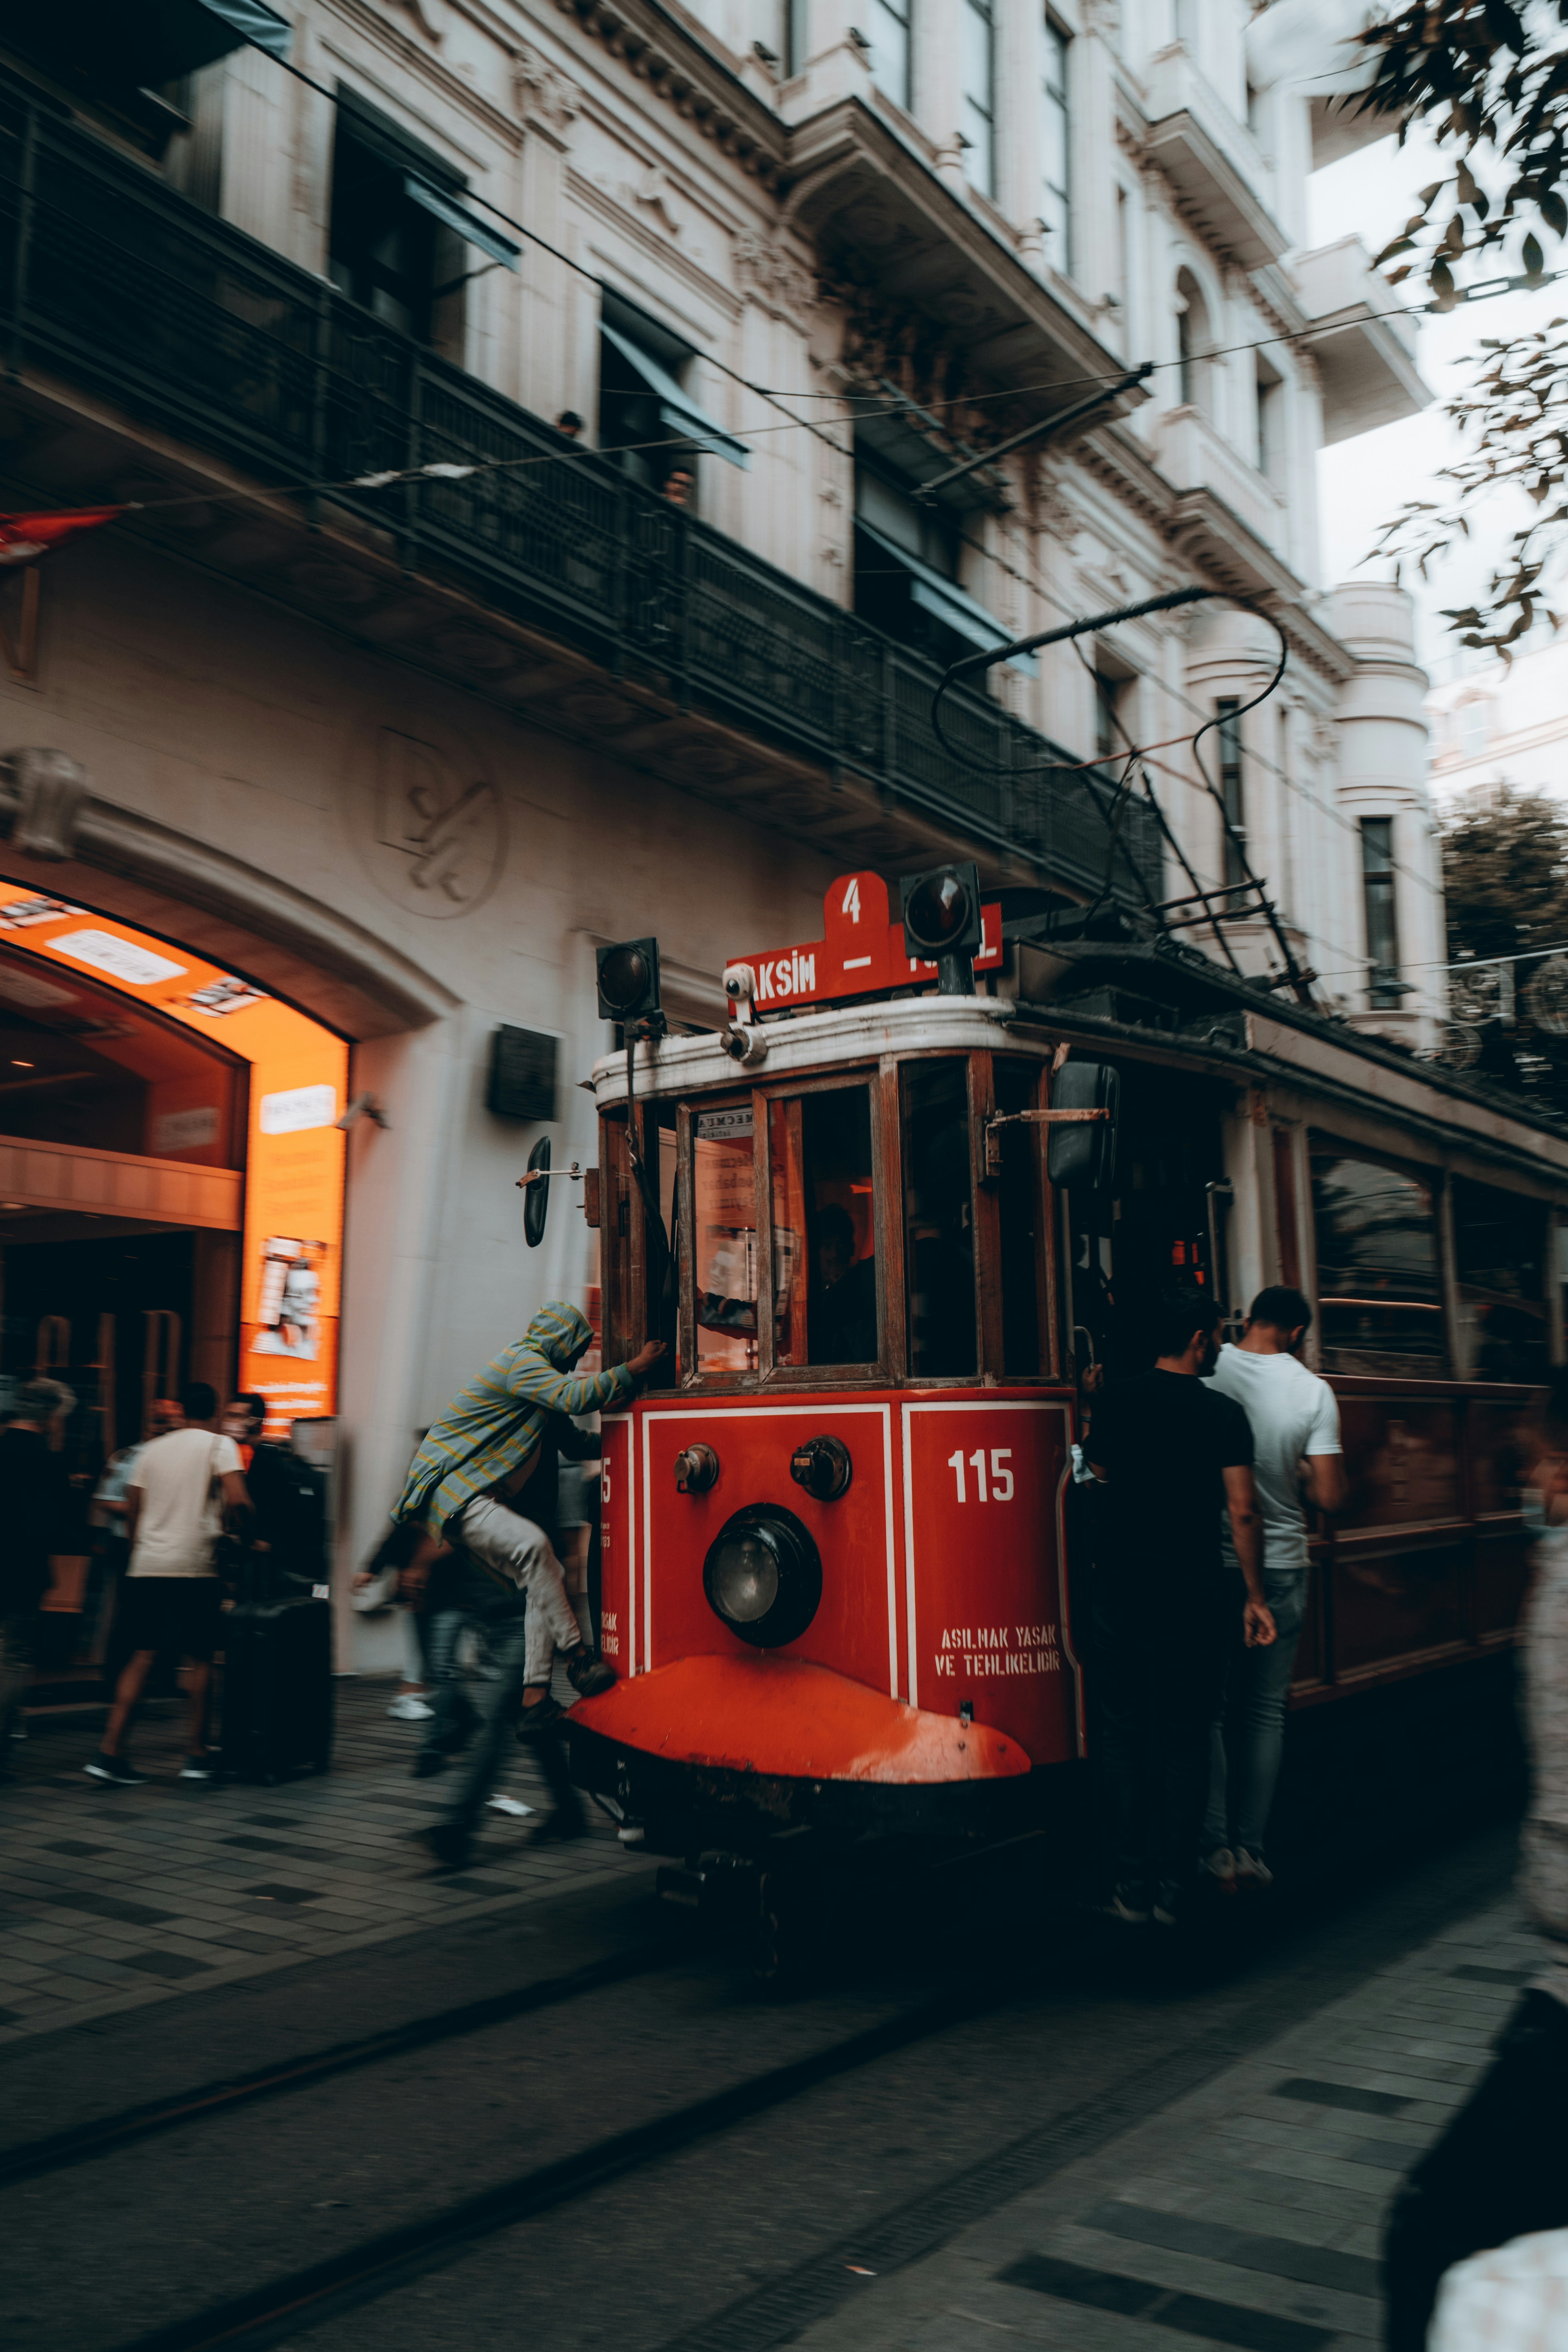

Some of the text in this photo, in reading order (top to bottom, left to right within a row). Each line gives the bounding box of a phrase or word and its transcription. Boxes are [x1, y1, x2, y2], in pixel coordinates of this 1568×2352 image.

[842, 878, 861, 924] 4
[750, 949, 816, 1002] KSİM
[948, 1448, 1014, 1503] 115
[941, 1623, 1056, 1650] ASILMAK YASAK
[935, 1654, 955, 1677] VE
